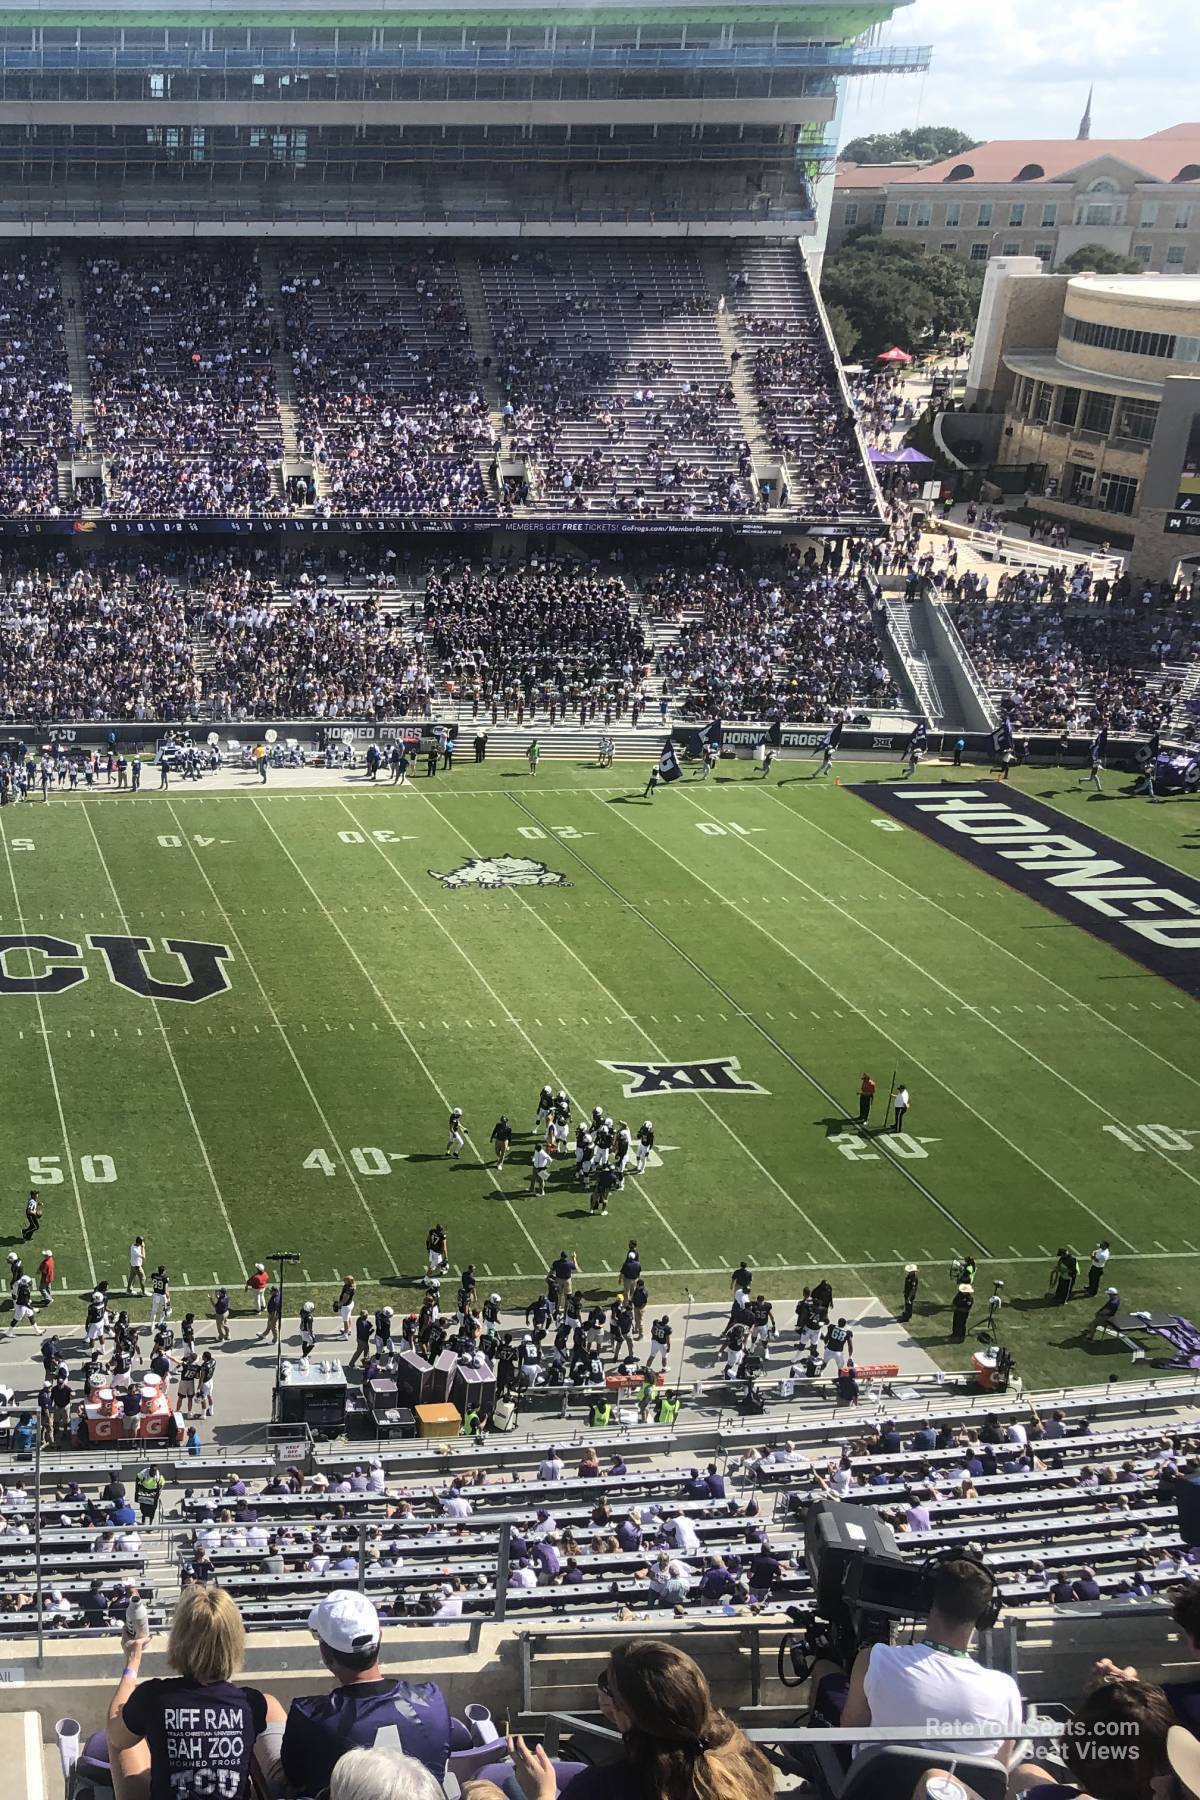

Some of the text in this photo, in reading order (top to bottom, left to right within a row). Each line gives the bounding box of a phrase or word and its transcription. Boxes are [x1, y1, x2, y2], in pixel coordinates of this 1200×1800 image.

[505, 523, 544, 531] MEMBERS
[546, 523, 561, 531] GET
[562, 523, 583, 531] FREE
[584, 523, 620, 531] TICKETS!
[622, 525, 724, 533] GoFrogs.com/MemberBenefits
[49, 729, 76, 742] TCU
[379, 727, 422, 739] FROGS
[517, 826, 584, 840] 20
[695, 822, 751, 836] 10
[157, 833, 215, 848] 40
[336, 830, 400, 844] 30
[1101, 1122, 1195, 1152] 10
[827, 1132, 930, 1161] 20
[302, 1146, 393, 1176] 40
[27, 1154, 118, 1185] 50
[831, 1328, 847, 1341] 68
[526, 1345, 538, 1358] 13
[164, 1708, 244, 1730] RIFF RAM
[167, 1736, 244, 1760] BAH ZOO
[169, 1758, 241, 1768] HORNED FROGS
[170, 1768, 240, 1800] TCU
